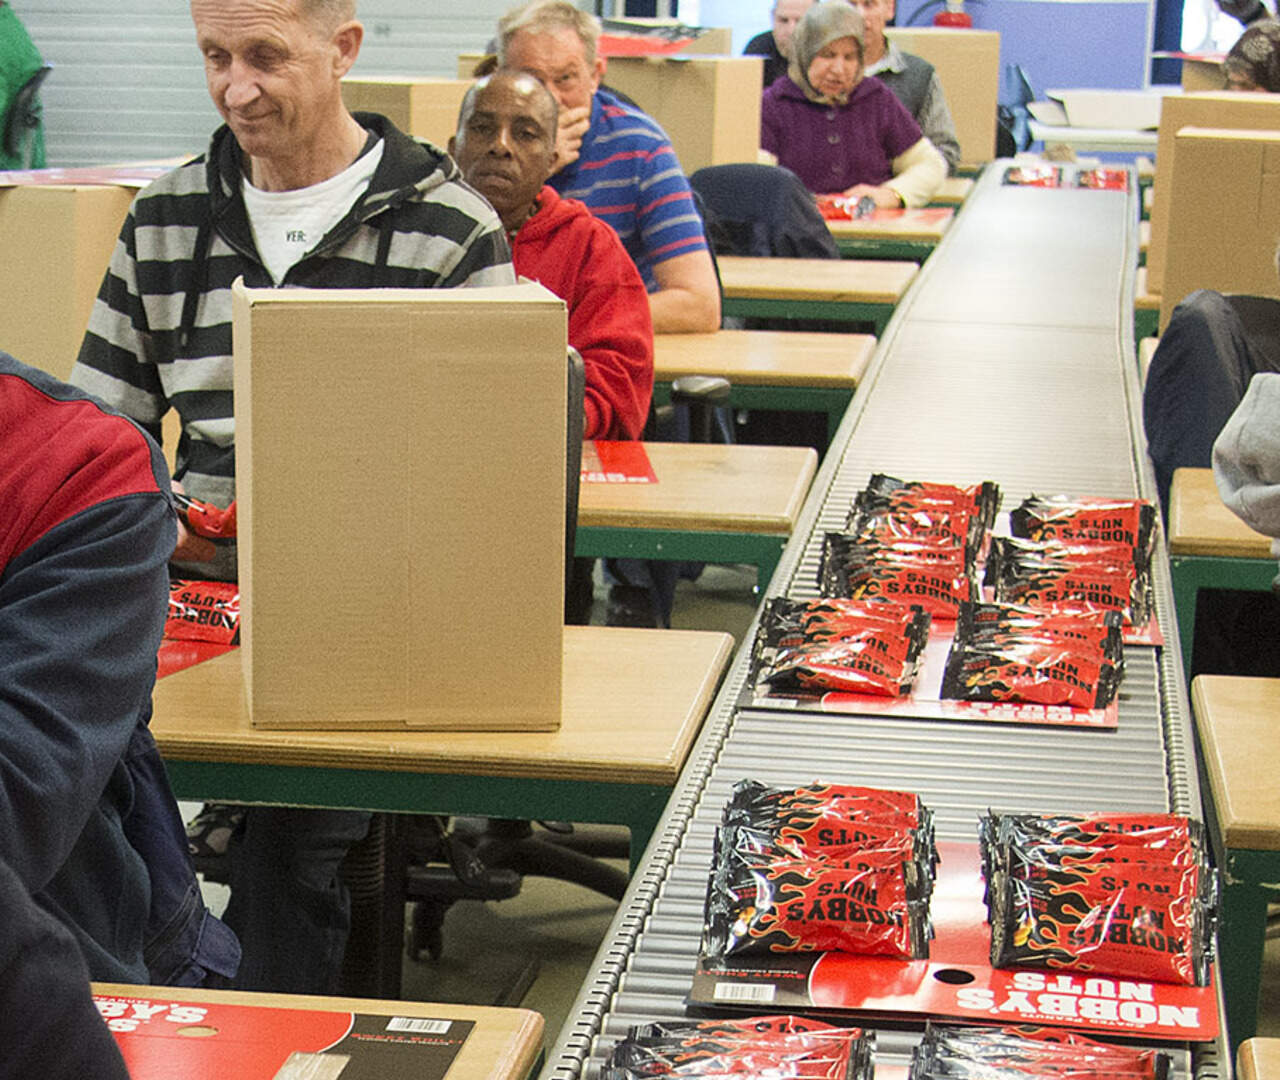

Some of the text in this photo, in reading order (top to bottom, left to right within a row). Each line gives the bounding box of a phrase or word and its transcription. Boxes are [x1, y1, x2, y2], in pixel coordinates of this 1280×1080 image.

[906, 572, 952, 591] NUTS
[1012, 972, 1156, 1001] NUTS
[955, 988, 1201, 1028] NOBBY'S
